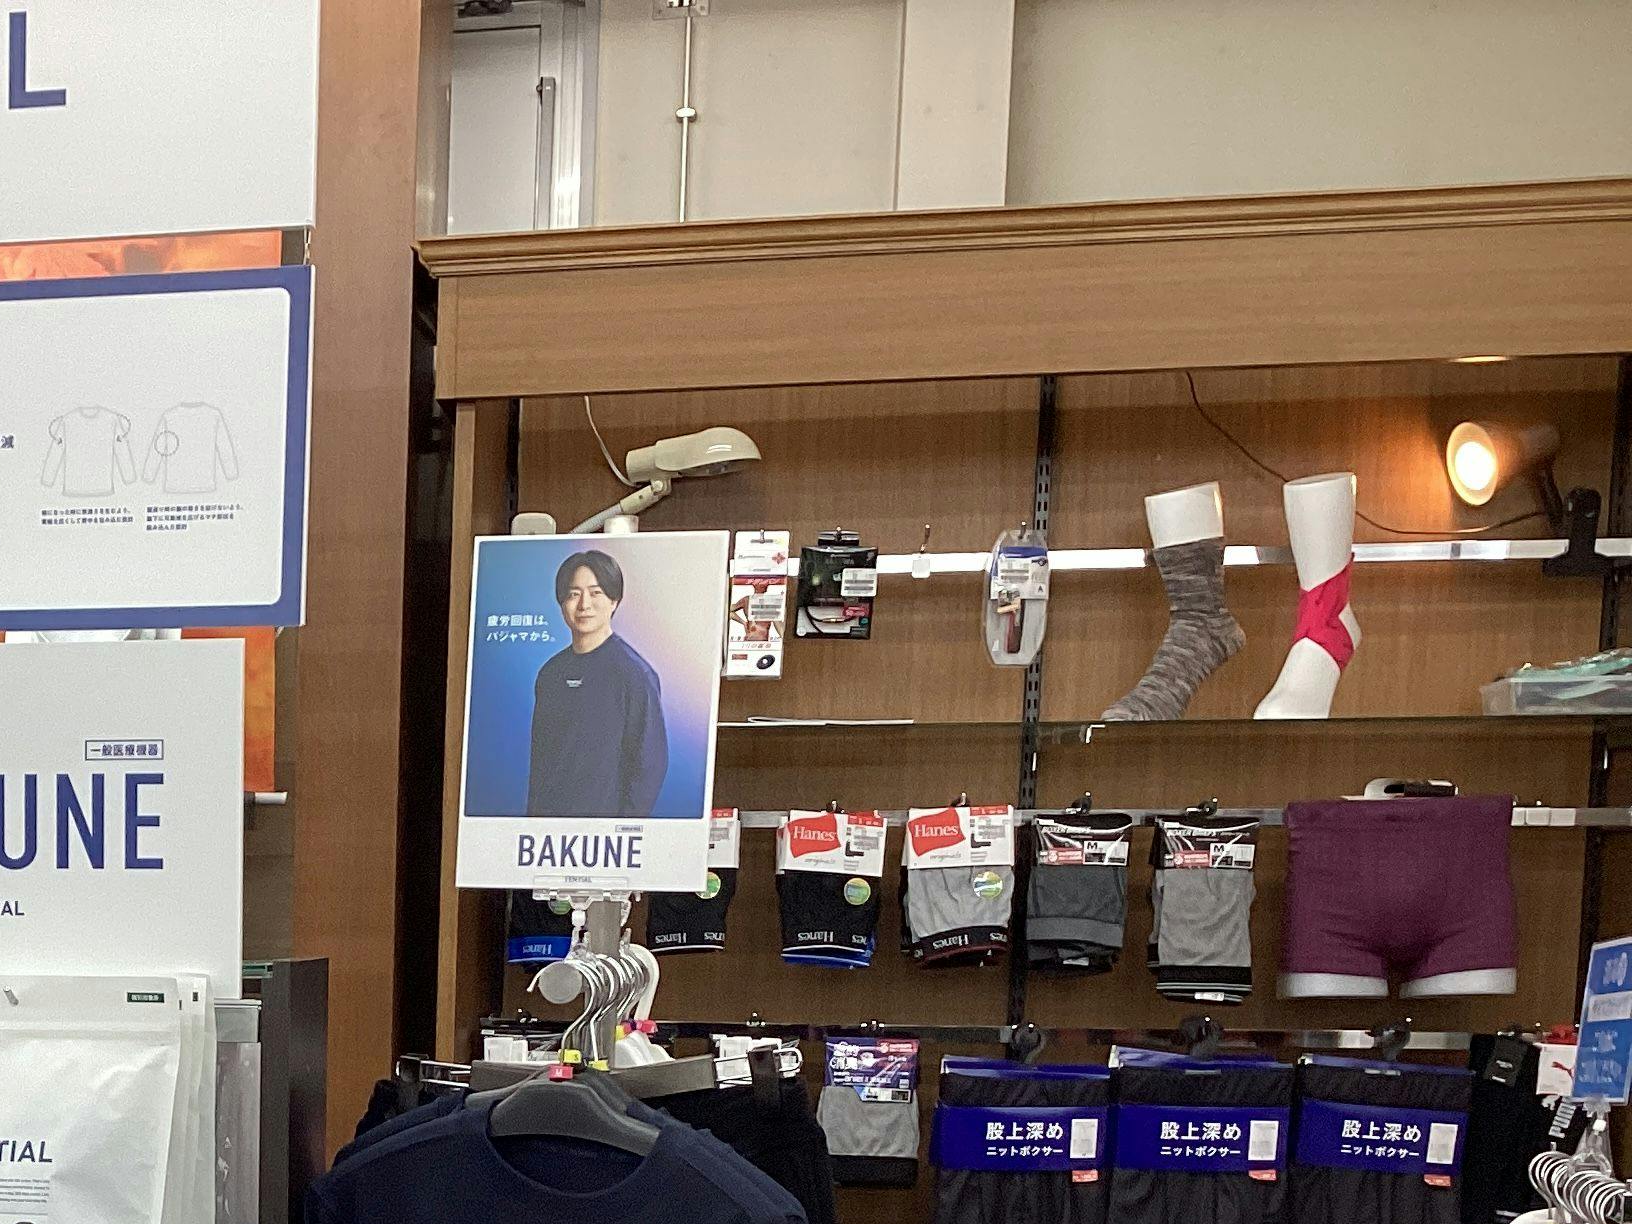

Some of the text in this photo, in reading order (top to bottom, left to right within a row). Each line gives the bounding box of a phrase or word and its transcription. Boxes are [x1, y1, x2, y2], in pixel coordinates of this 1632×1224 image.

[487, 613, 549, 628] 疲労回復は、
[486, 630, 556, 643] パジャマから。
[793, 826, 836, 842] Hanes
[914, 824, 958, 838] Hanes
[518, 834, 643, 868] BAKUNE
[1087, 842, 1099, 850] M
[1213, 844, 1225, 852] M
[655, 932, 687, 943] Hanes
[798, 931, 834, 943] Hanes
[933, 934, 968, 949] Hanes
[985, 1121, 1064, 1141] 股上深め
[1160, 1120, 1242, 1142] 股上深め
[1341, 1119, 1422, 1143] 股上深め
[986, 1145, 1064, 1157] ニットボクサー
[1160, 1145, 1242, 1158] ニットボクサー
[1340, 1144, 1420, 1159] ニットボクサー
